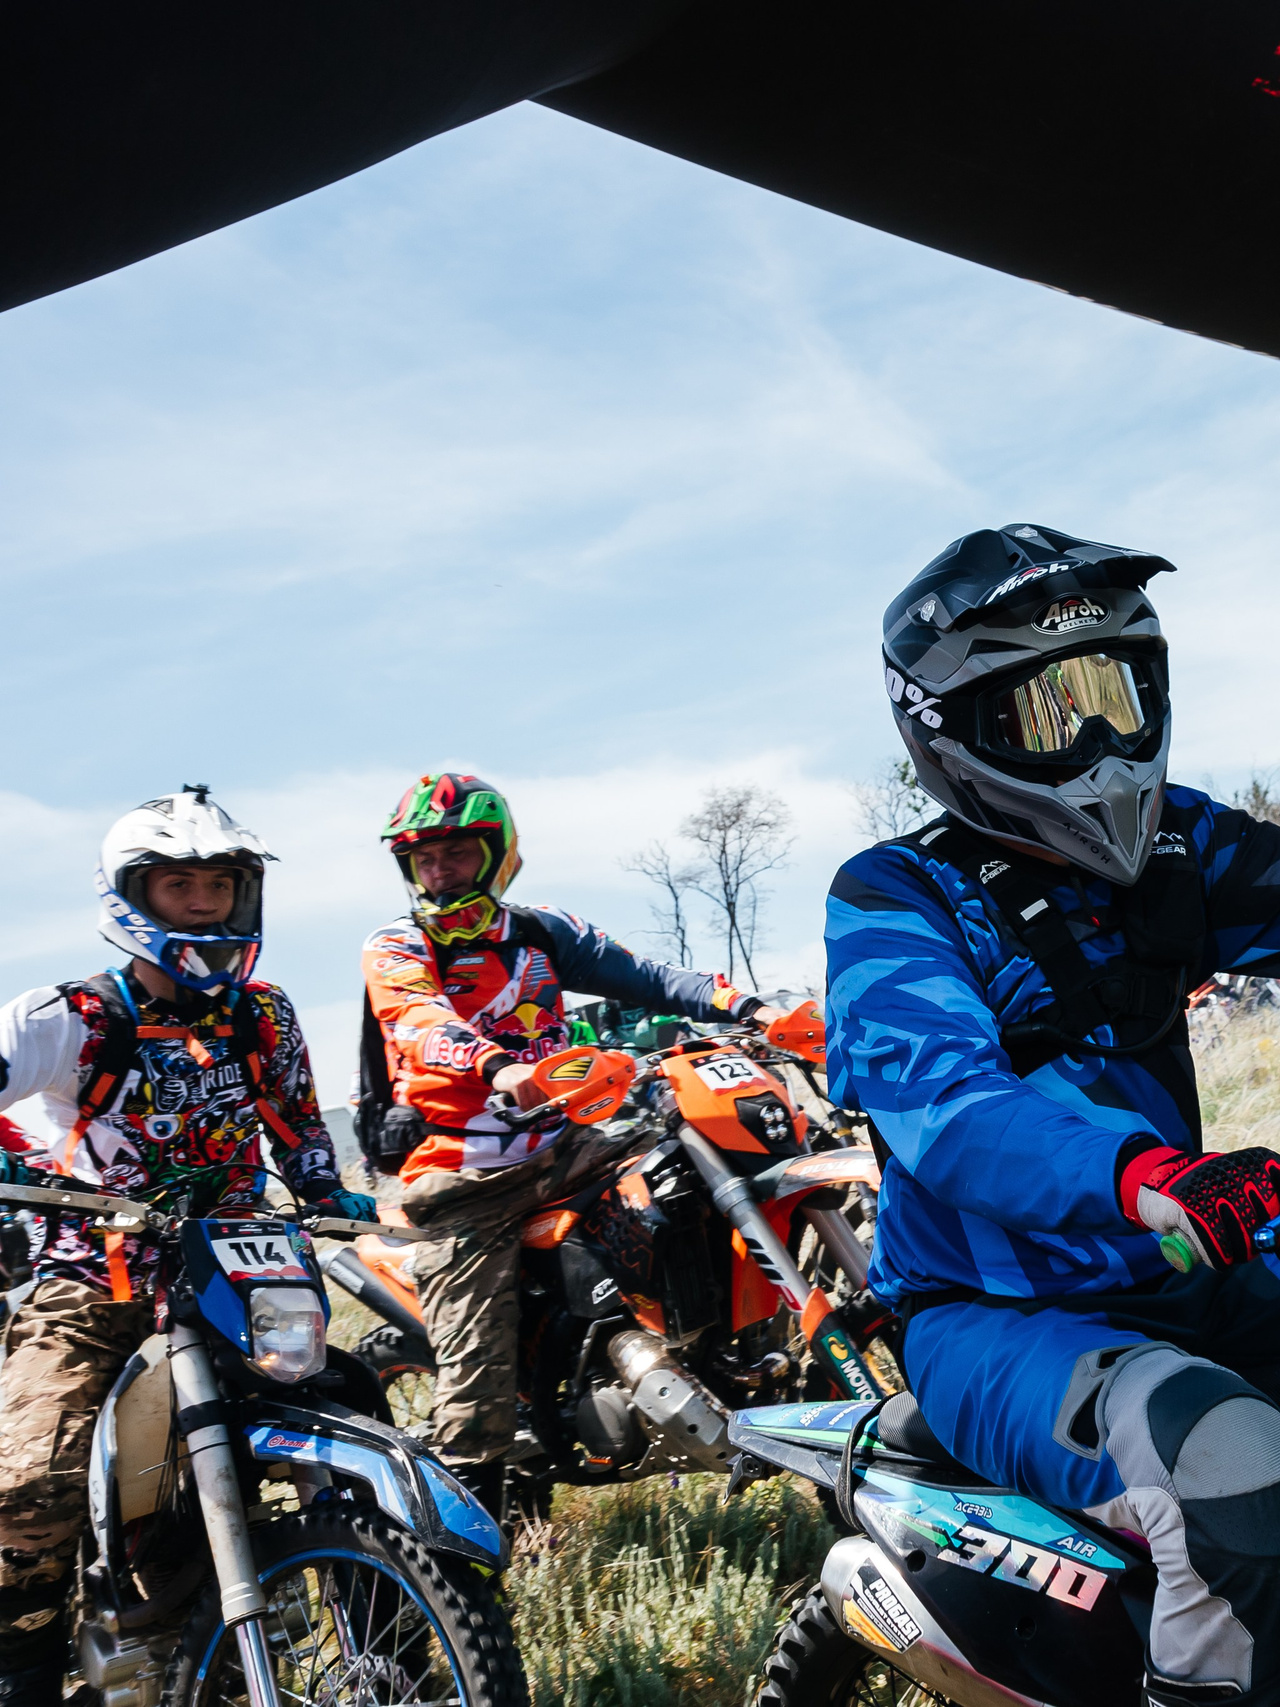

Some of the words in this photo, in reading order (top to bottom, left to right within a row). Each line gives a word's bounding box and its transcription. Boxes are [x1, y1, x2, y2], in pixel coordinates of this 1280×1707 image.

[1041, 598, 1105, 628] Airoh
[882, 660, 943, 729] 0%
[1062, 822, 1111, 865] AIROH
[981, 863, 1011, 885] E-GEAR
[708, 1062, 753, 1081] 123
[228, 1242, 287, 1266] 114
[1057, 1536, 1098, 1558] AIR
[937, 1525, 1108, 1611] 300
[868, 1577, 921, 1640] PROGASI
